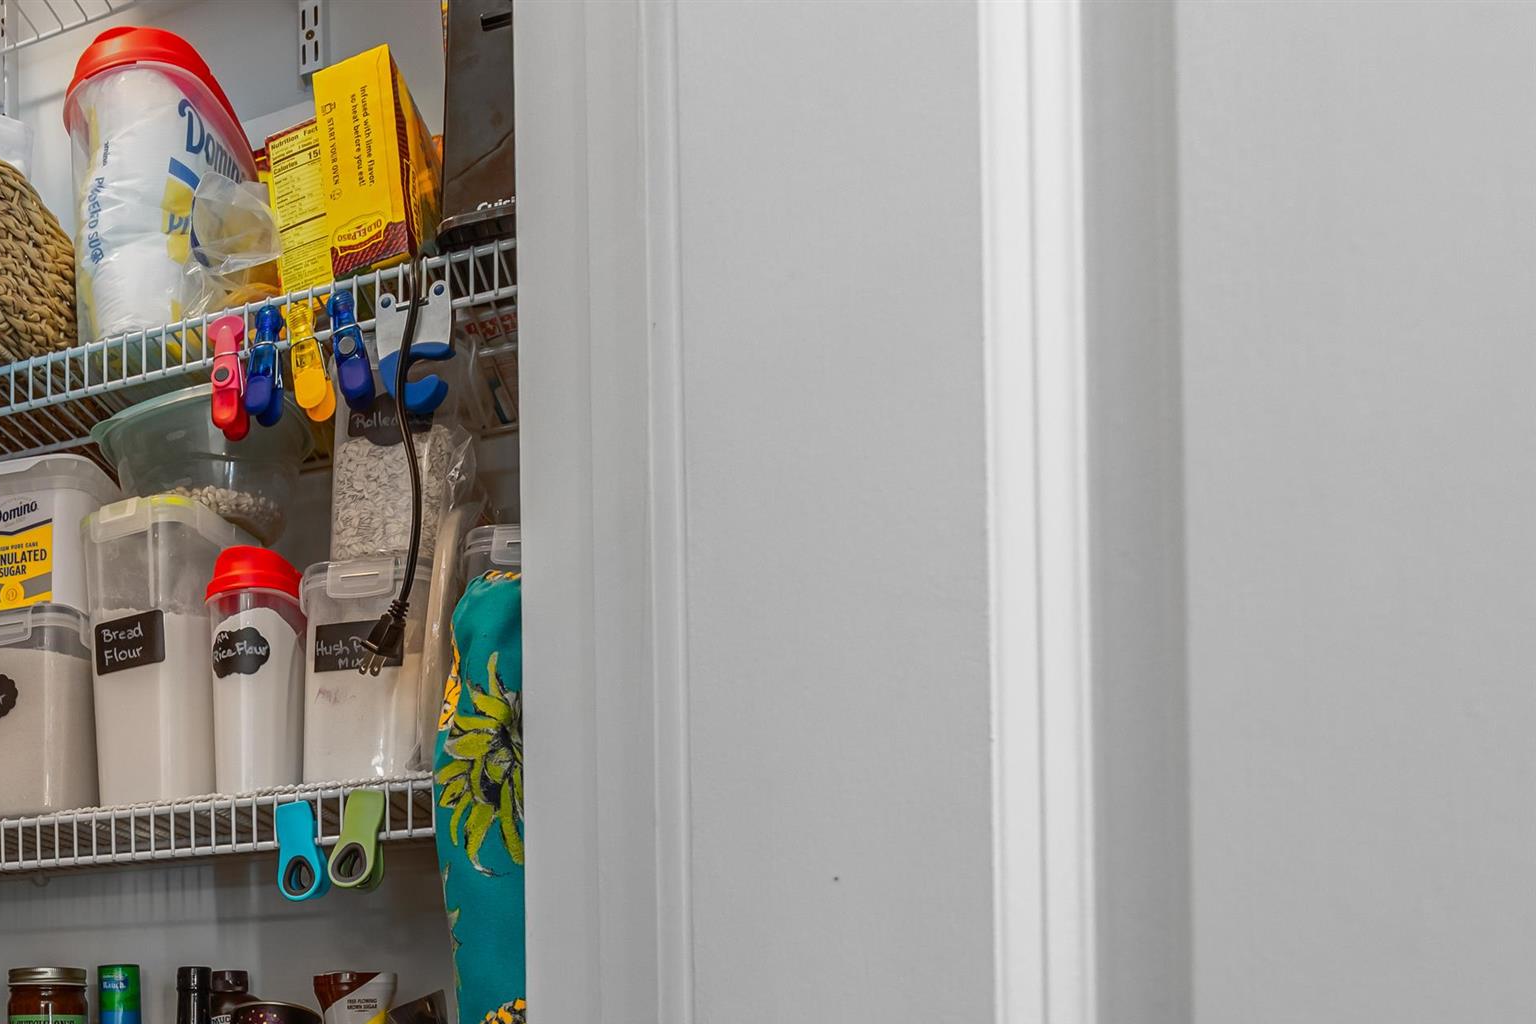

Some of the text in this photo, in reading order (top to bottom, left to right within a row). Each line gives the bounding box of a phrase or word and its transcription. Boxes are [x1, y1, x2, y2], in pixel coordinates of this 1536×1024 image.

[270, 133, 299, 150] Nutrition
[354, 124, 362, 154] before
[360, 84, 376, 187] Infused with lime flavor.
[327, 117, 340, 186] START YOUR OVEN
[273, 160, 298, 176] Calories
[354, 154, 364, 171] you
[358, 170, 366, 187] eat!
[351, 413, 398, 429] Rolled
[10, 543, 25, 552] PURE
[25, 541, 39, 549] CANE
[102, 621, 143, 644] Bread
[104, 647, 143, 666] Flour
[235, 643, 270, 657] Flour
[315, 639, 350, 657] Hush
